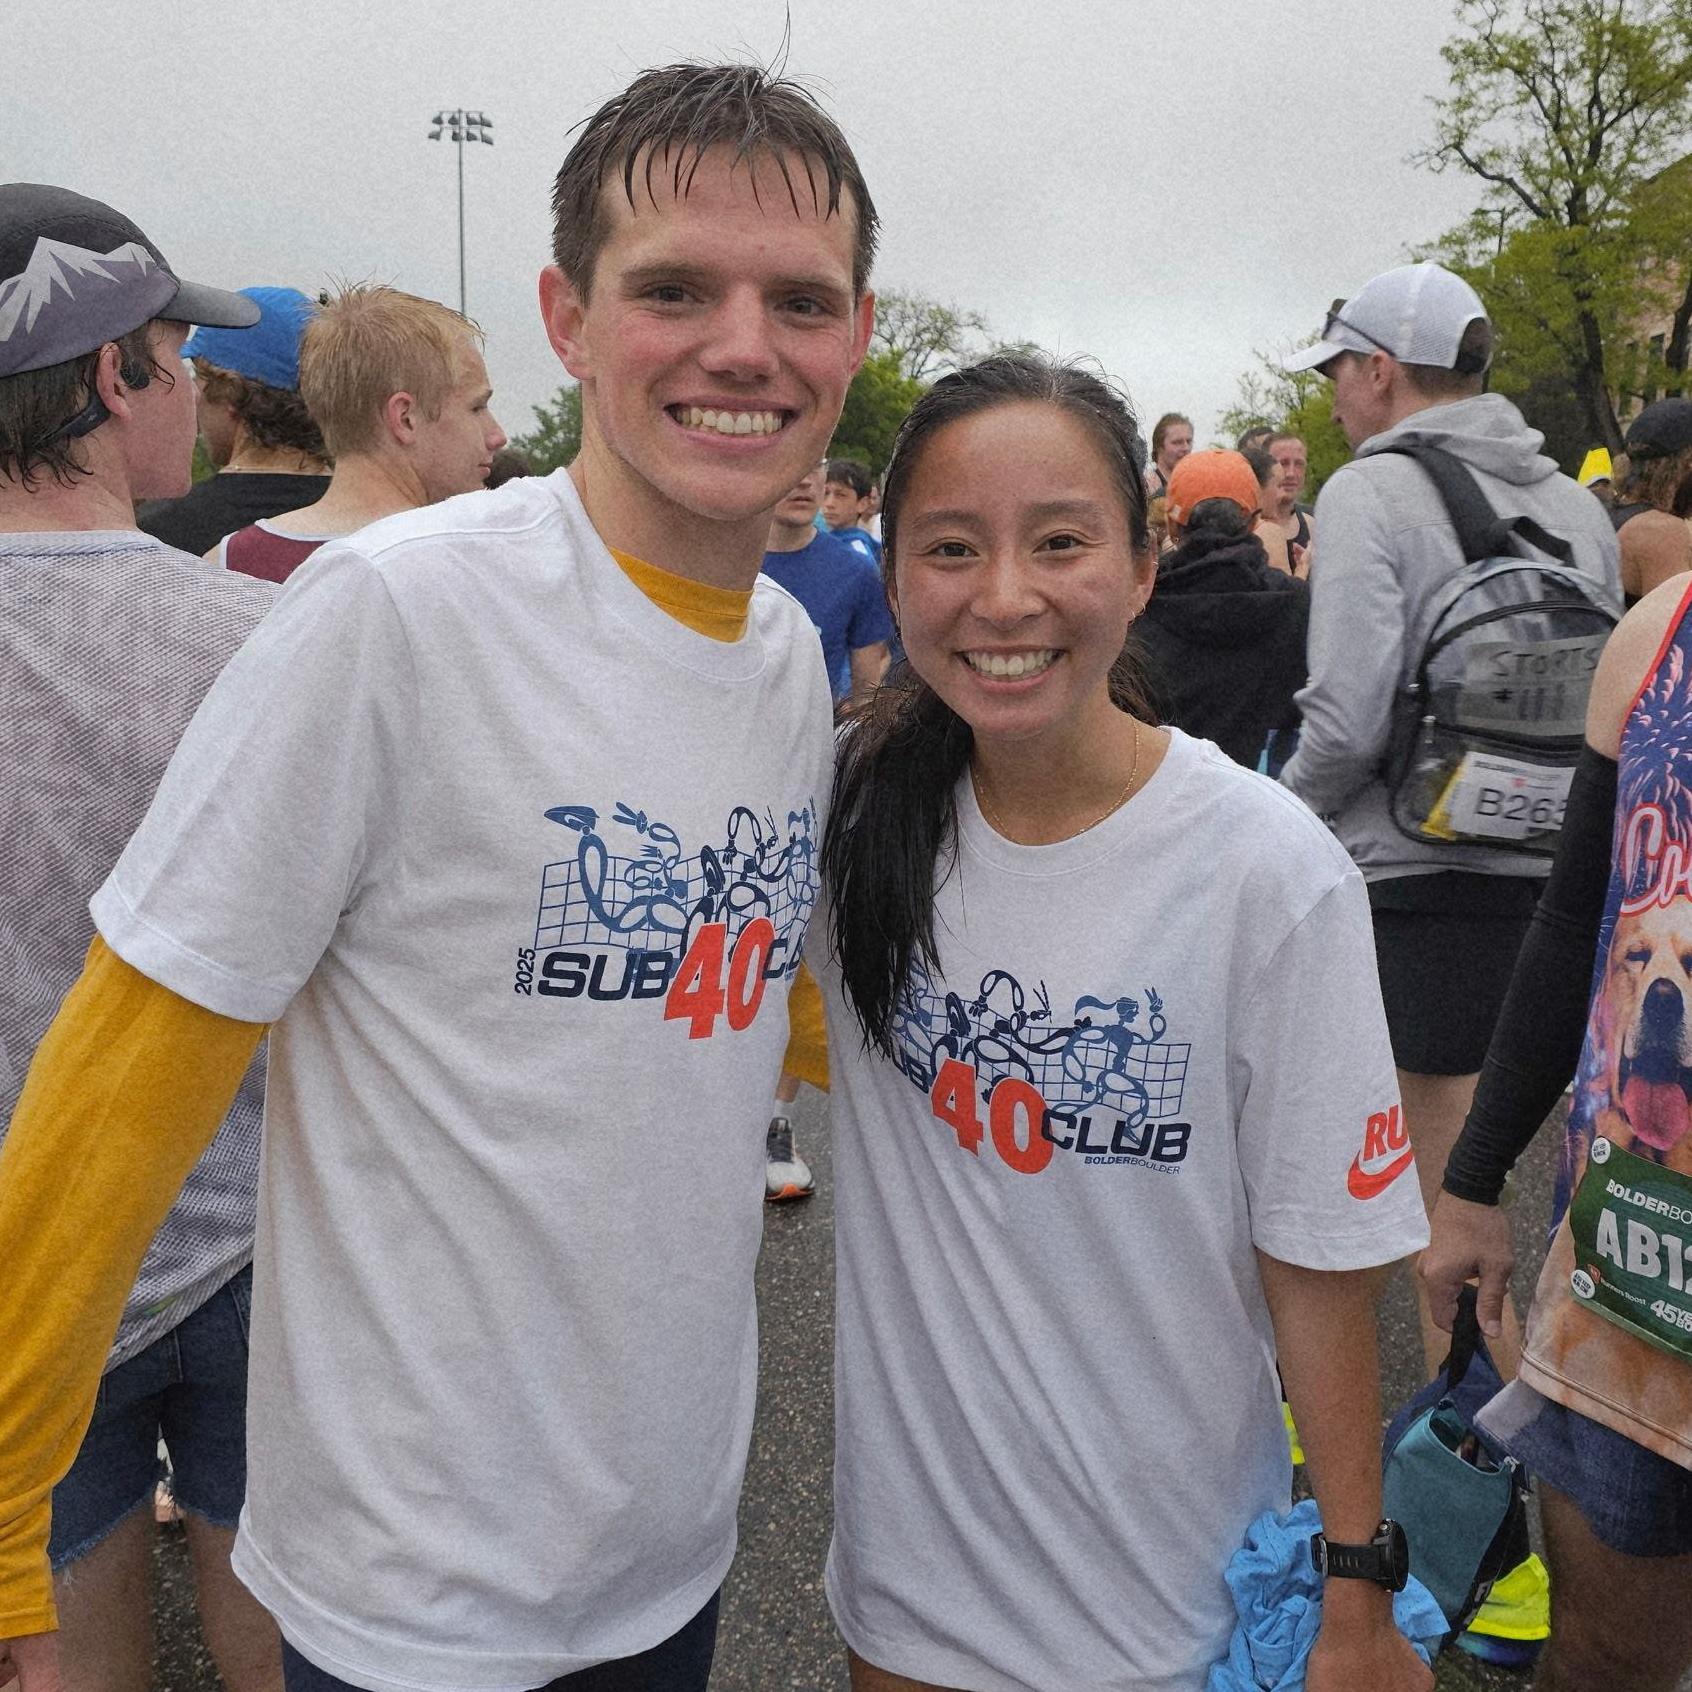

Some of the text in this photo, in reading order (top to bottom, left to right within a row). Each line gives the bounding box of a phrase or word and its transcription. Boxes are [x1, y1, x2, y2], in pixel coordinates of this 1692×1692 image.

[1620, 803, 1692, 915] Co
[514, 947, 536, 996] 2025
[537, 916, 804, 1040] SUB 40 CL
[930, 1057, 1055, 1175] 40
[1041, 1108, 1192, 1163] CLUB
[1084, 1155, 1181, 1175] BOLDERBOULDER
[1605, 1178, 1692, 1225] BOLDERBO
[1650, 1299, 1680, 1324] 45
